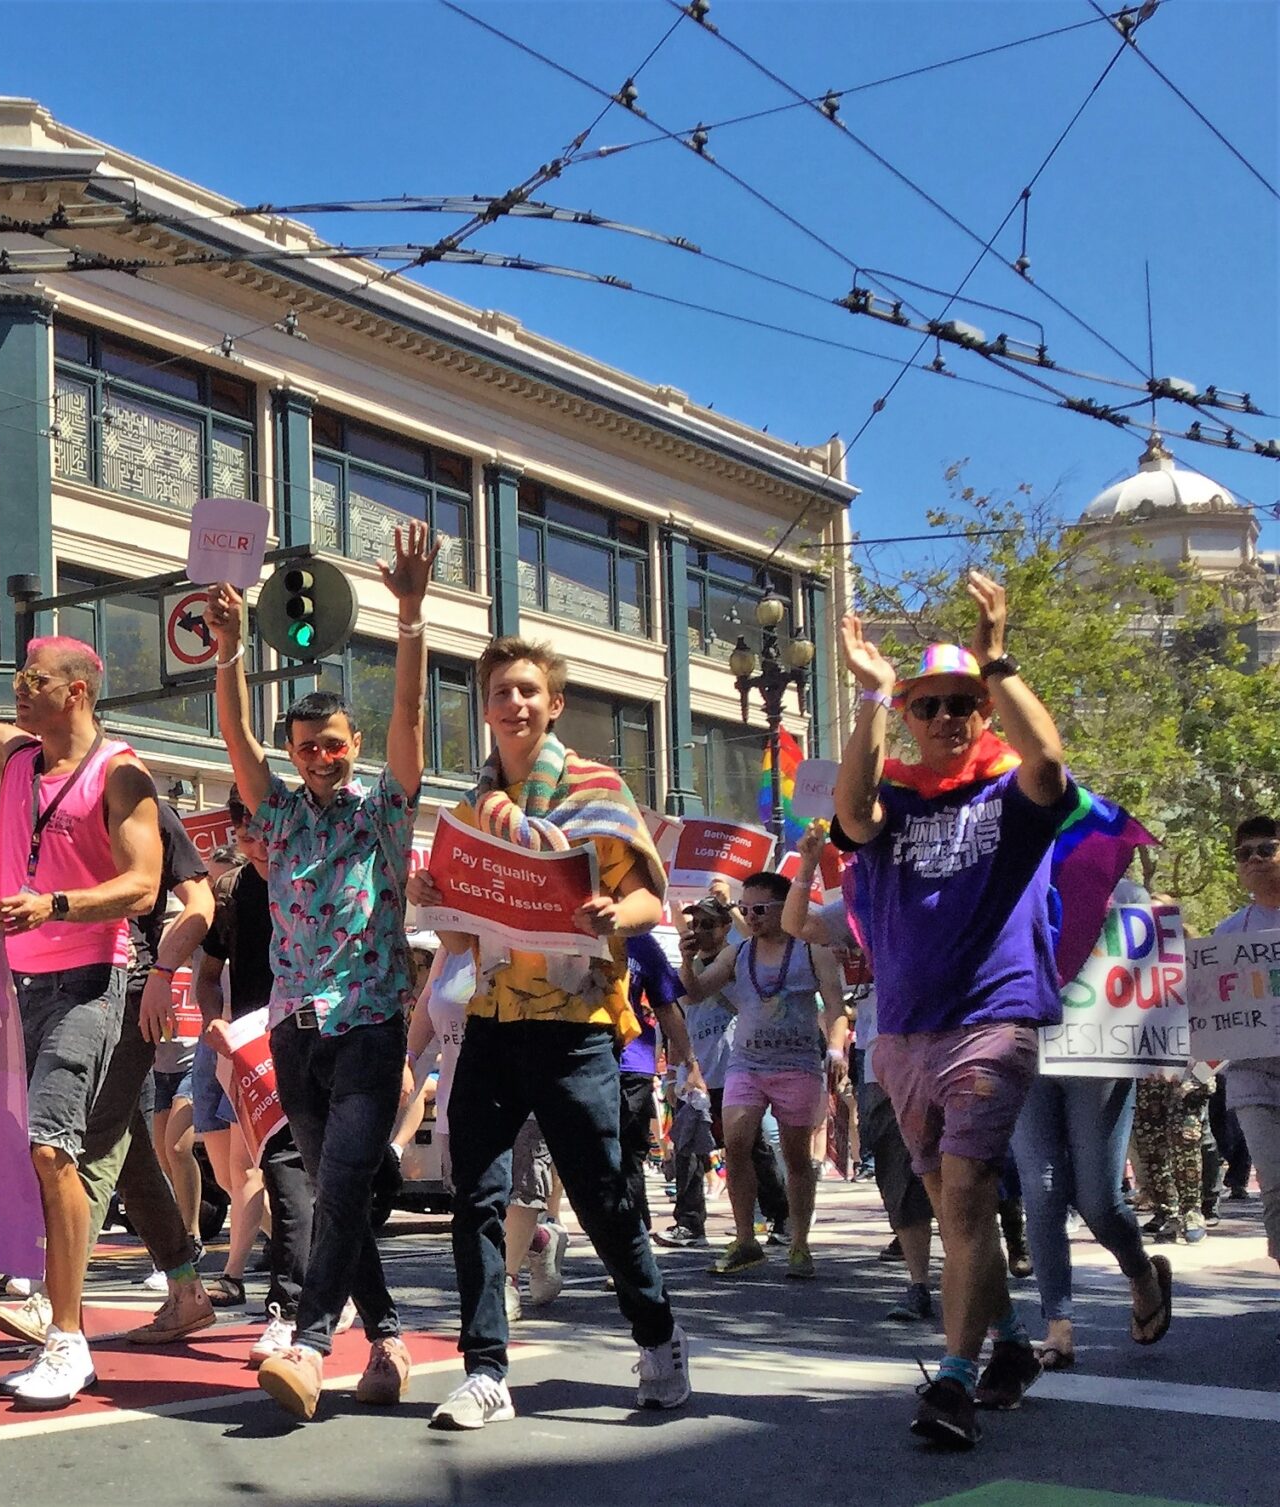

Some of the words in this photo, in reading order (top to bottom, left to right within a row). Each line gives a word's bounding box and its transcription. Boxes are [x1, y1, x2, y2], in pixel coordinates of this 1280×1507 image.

[203, 532, 249, 550] NCLR
[703, 828, 752, 848] Bathrooms
[452, 846, 478, 869] Pay
[482, 858, 548, 887] Equality
[695, 847, 728, 860] LGBTQ
[729, 852, 753, 868] Issues
[449, 878, 505, 904] LGBTQ
[509, 895, 563, 912] Issues
[1104, 965, 1186, 1010] OUR
[1211, 1009, 1267, 1032] THEIR
[1042, 1022, 1191, 1057] RESISTANCE
